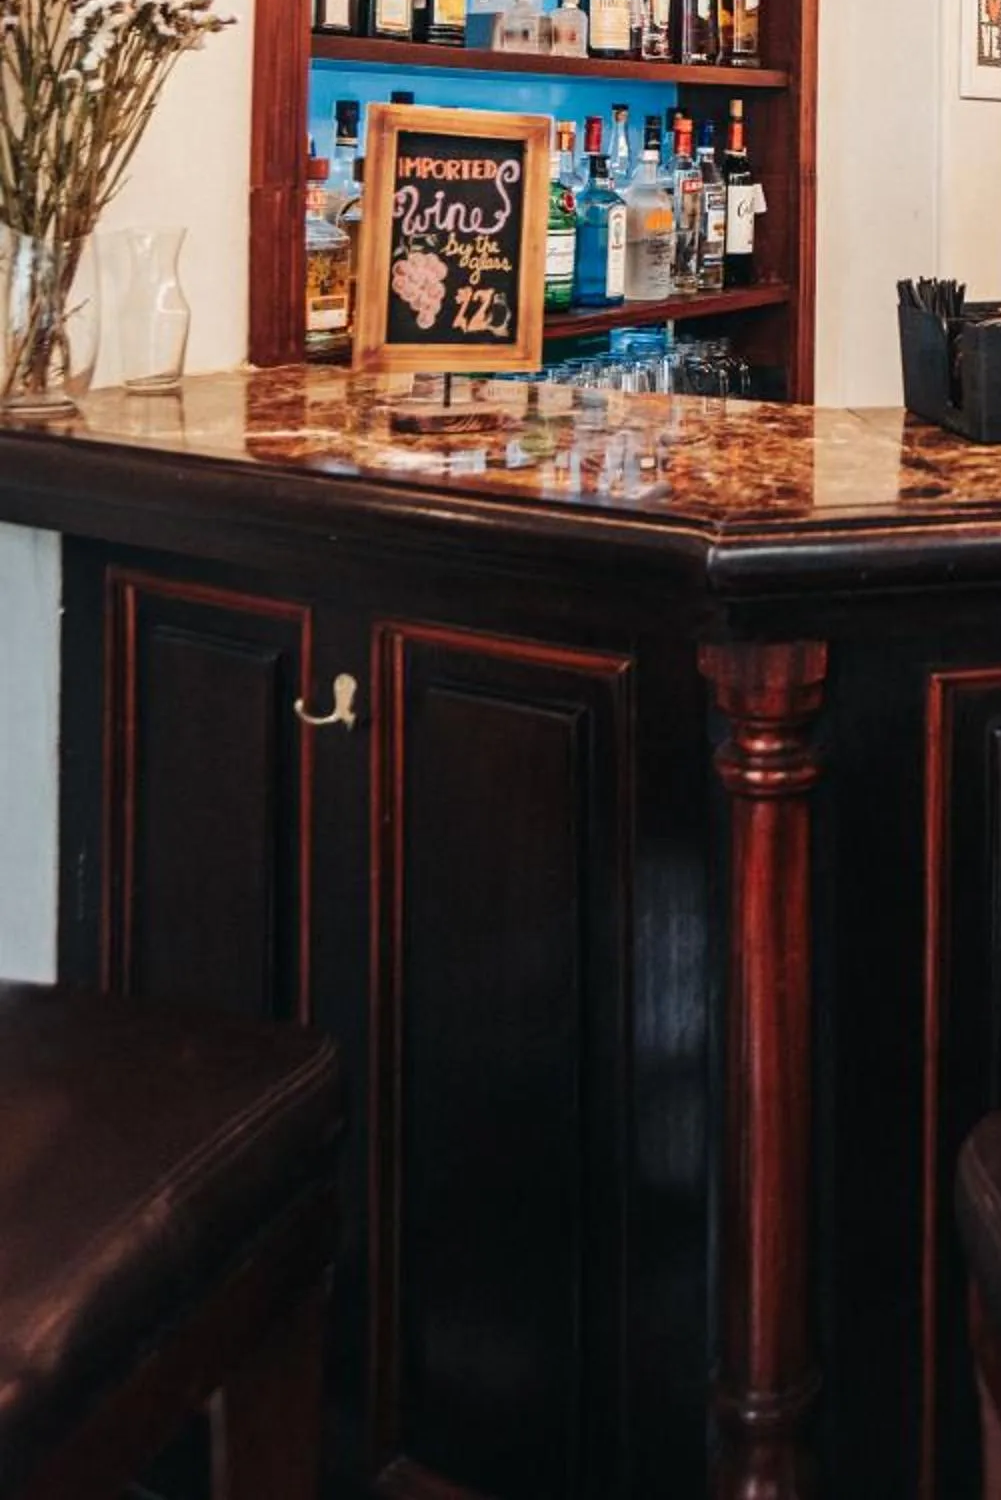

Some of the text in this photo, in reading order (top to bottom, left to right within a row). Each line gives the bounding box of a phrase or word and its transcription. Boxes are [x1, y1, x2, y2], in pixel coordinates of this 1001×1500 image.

[399, 156, 498, 180] IMPORTED
[441, 232, 501, 269] by the
[468, 252, 513, 285] glass
